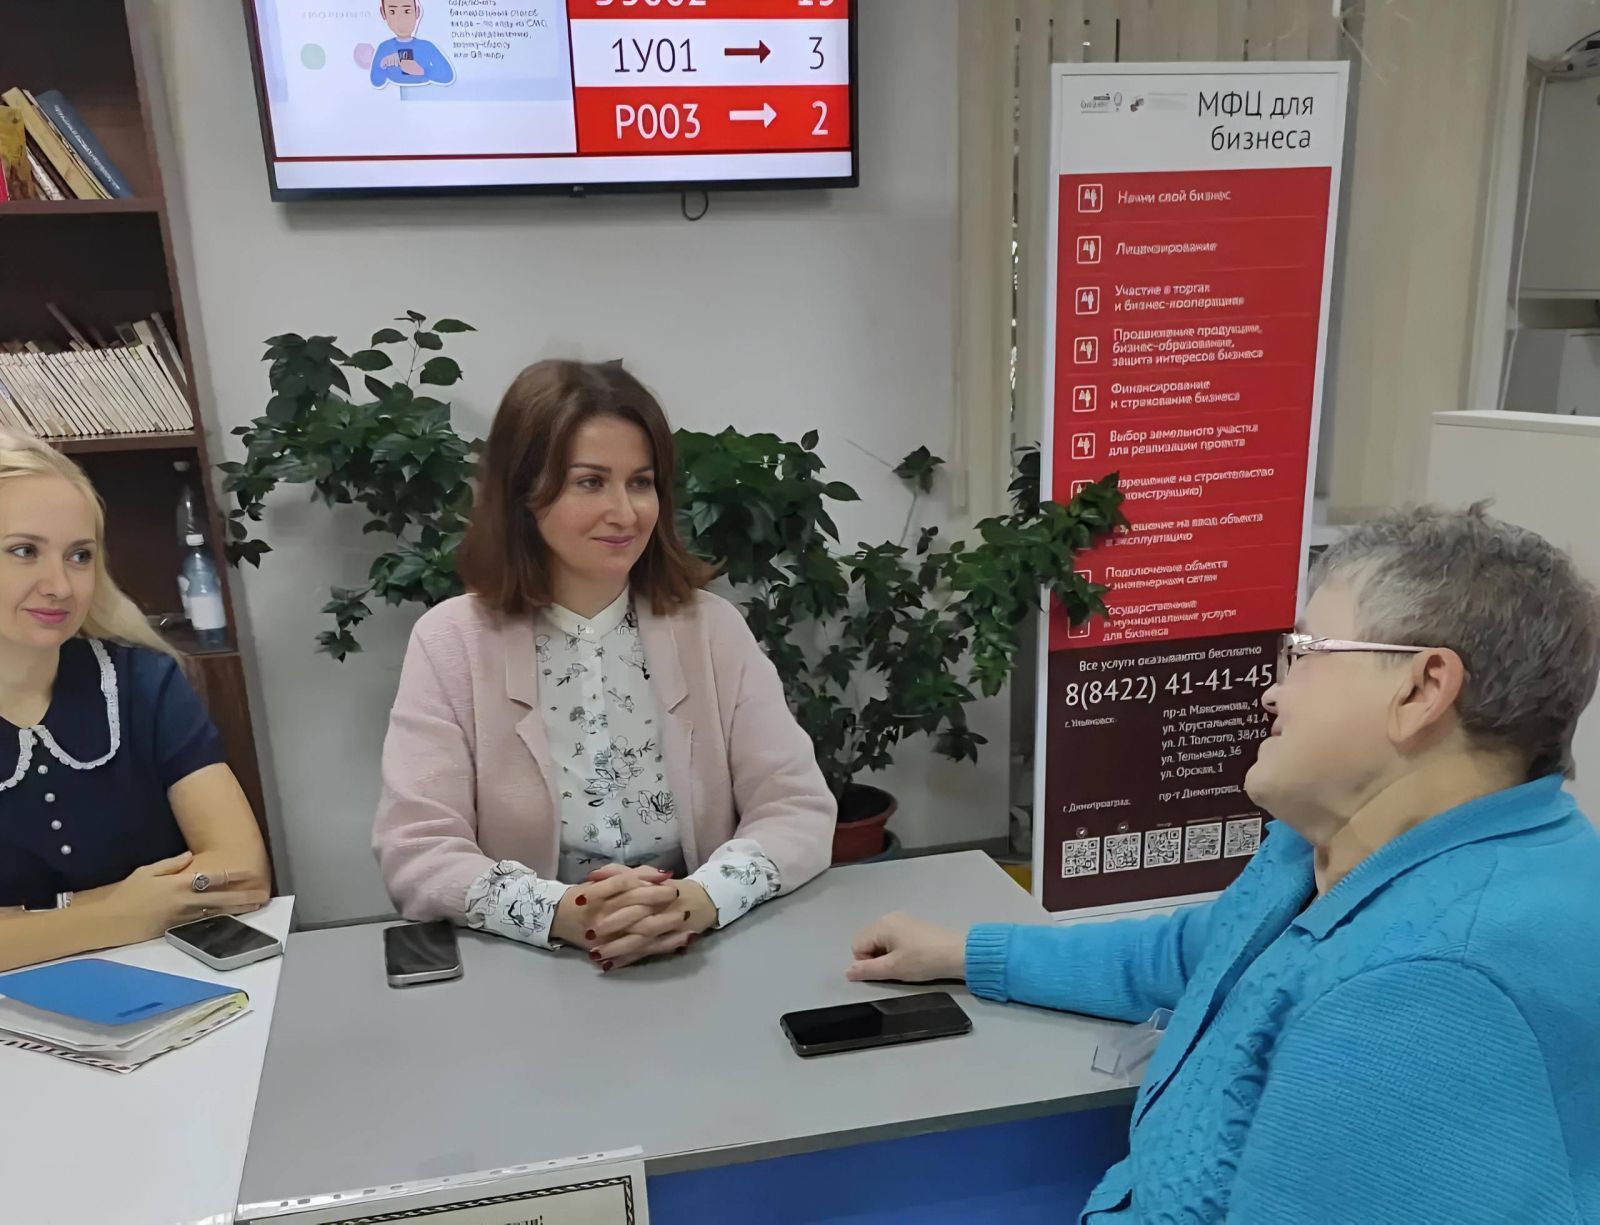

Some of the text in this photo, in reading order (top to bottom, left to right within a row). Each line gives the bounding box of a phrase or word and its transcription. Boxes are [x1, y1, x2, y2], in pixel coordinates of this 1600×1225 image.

[611, 38, 698, 73] 1У01
[809, 36, 825, 70] 3
[1198, 90, 1314, 120] МФЦ для
[615, 103, 701, 140] Р003
[811, 101, 829, 136] 2
[1211, 125, 1311, 151] бизнеса
[1189, 189, 1232, 202] бизнес
[1115, 284, 1161, 297] Участие
[1173, 284, 1210, 296] торгах
[1114, 302, 1122, 312] и
[1155, 352, 1216, 366] интересов
[1217, 348, 1264, 361] бизнеса
[1111, 380, 1211, 394] Финансирование
[1194, 392, 1240, 404] бизнеса
[1109, 430, 1147, 443] Выбор
[1150, 427, 1214, 440] земельного
[1108, 446, 1129, 457] для
[1178, 474, 1192, 483] на
[1176, 519, 1190, 529] на
[1079, 660, 1098, 672] Все
[1100, 657, 1135, 672] услуги
[1208, 646, 1262, 660] бесплатно
[1065, 664, 1273, 710] 8(8422) 41-41-45
[1163, 708, 1187, 719] пр-д
[1162, 724, 1176, 735] ул.
[1246, 714, 1259, 724] 41
[1261, 712, 1269, 722] А
[1161, 740, 1176, 751] ул.
[1190, 733, 1235, 745] Толстого,
[1237, 727, 1267, 741] 38/16
[1161, 755, 1175, 766] ул.
[1228, 745, 1242, 756] 36
[1160, 770, 1175, 781] ул.
[1217, 762, 1223, 773] 1
[1159, 791, 1181, 802] пр-т
